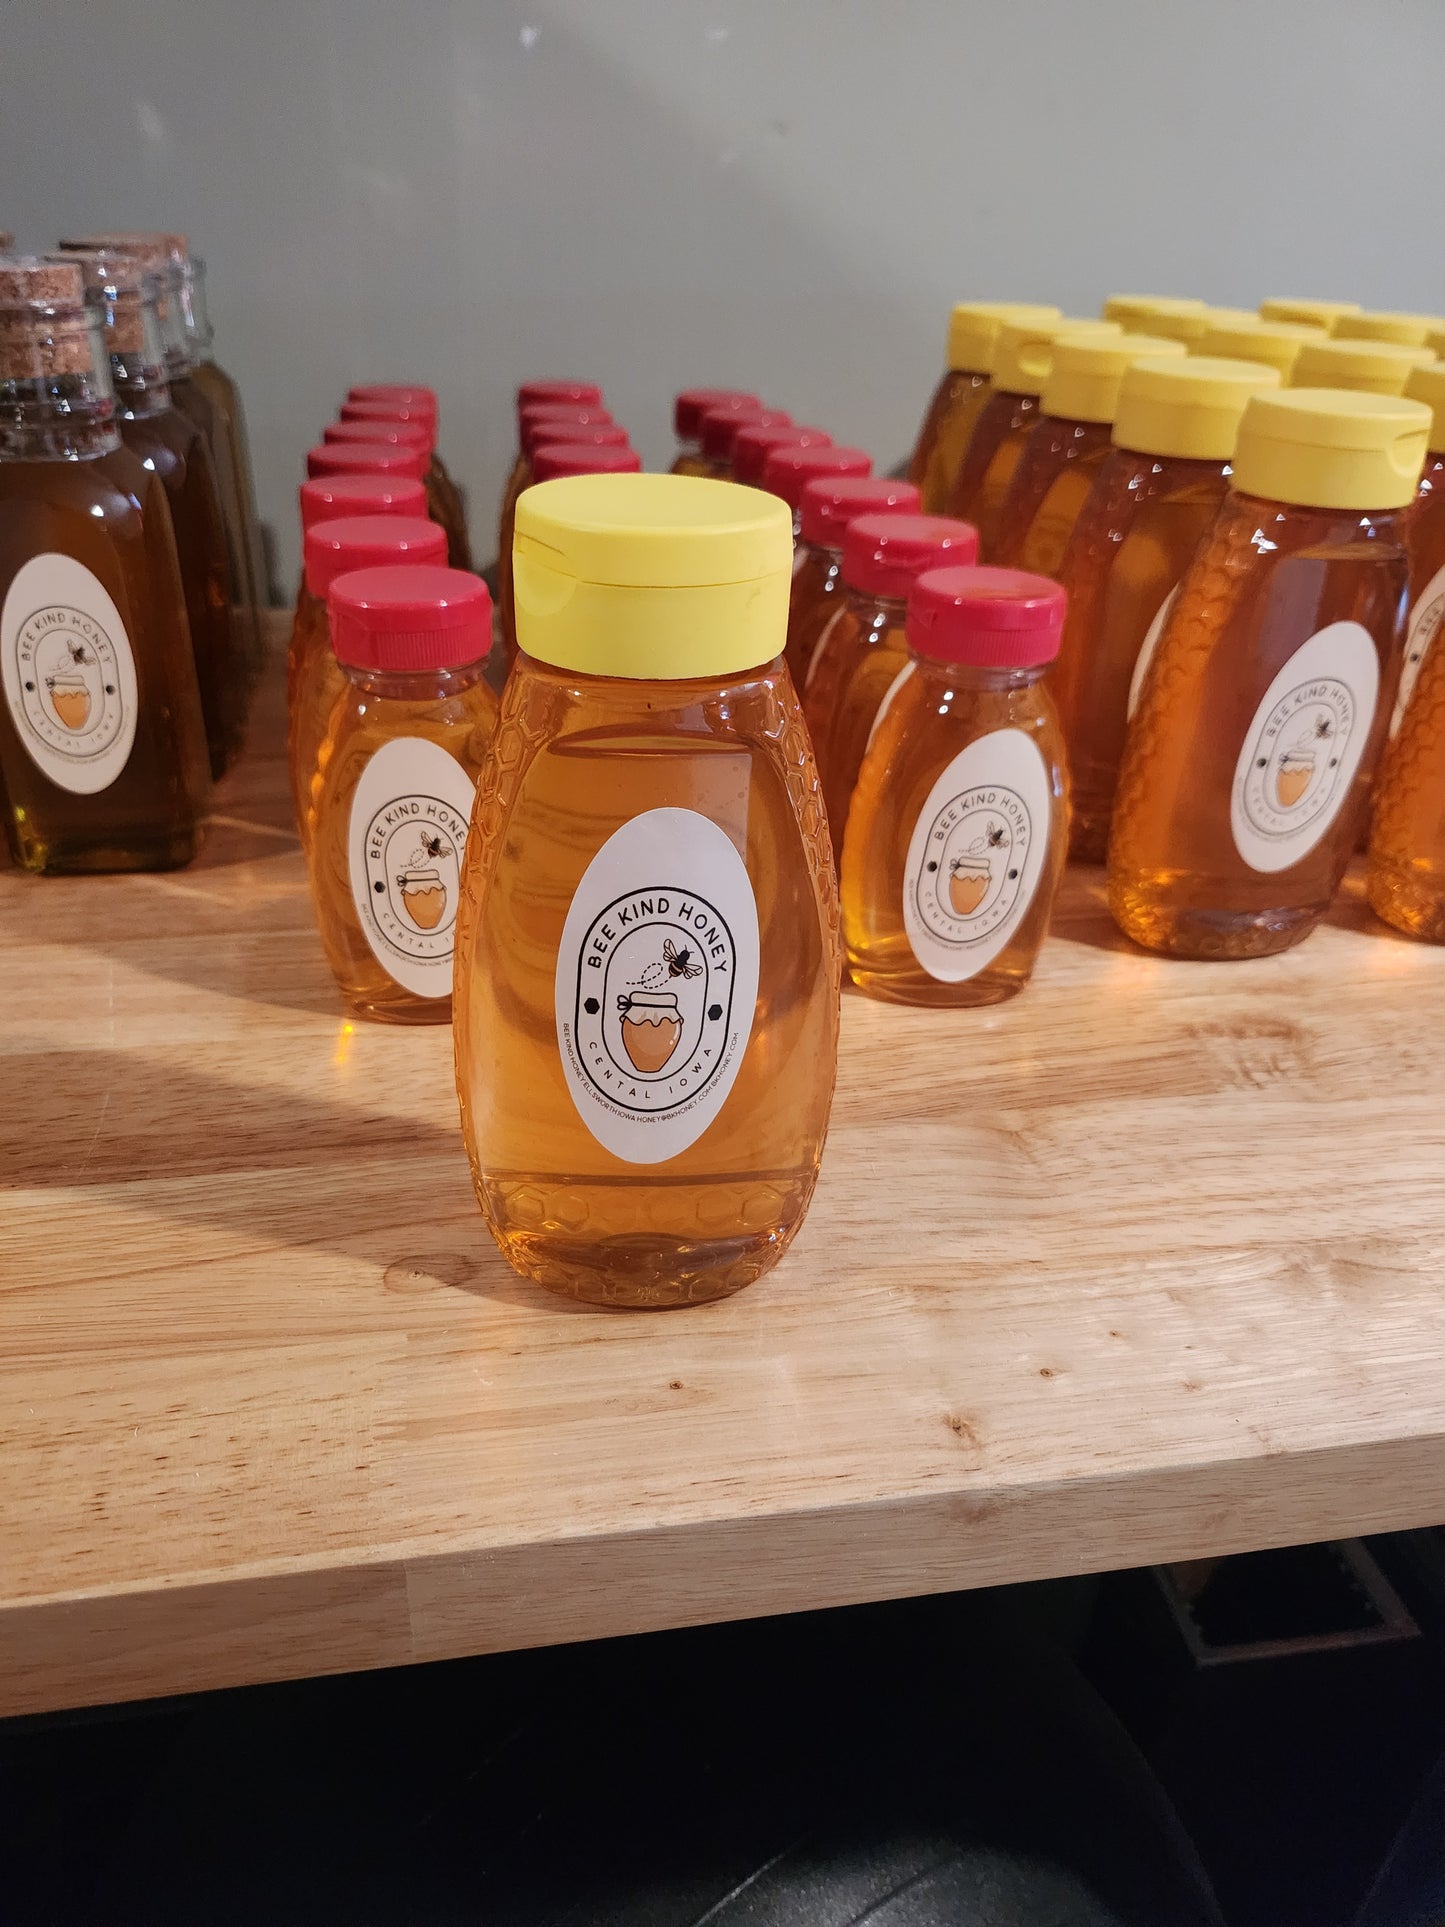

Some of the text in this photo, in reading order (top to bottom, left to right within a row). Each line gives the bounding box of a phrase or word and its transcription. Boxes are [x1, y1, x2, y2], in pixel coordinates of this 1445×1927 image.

[22, 612, 113, 665] BEE KIND HONEY
[370, 803, 466, 860] BEE KIND HONE
[934, 793, 1027, 848] BEE KIND HONEY
[587, 897, 728, 973] BEE KIND HONEY
[563, 1022, 571, 1038] BEE
[564, 1038, 575, 1057] KIND
[589, 1041, 713, 1099] CENTAL IOWA
[582, 1081, 619, 1116] ELLSWORTH
